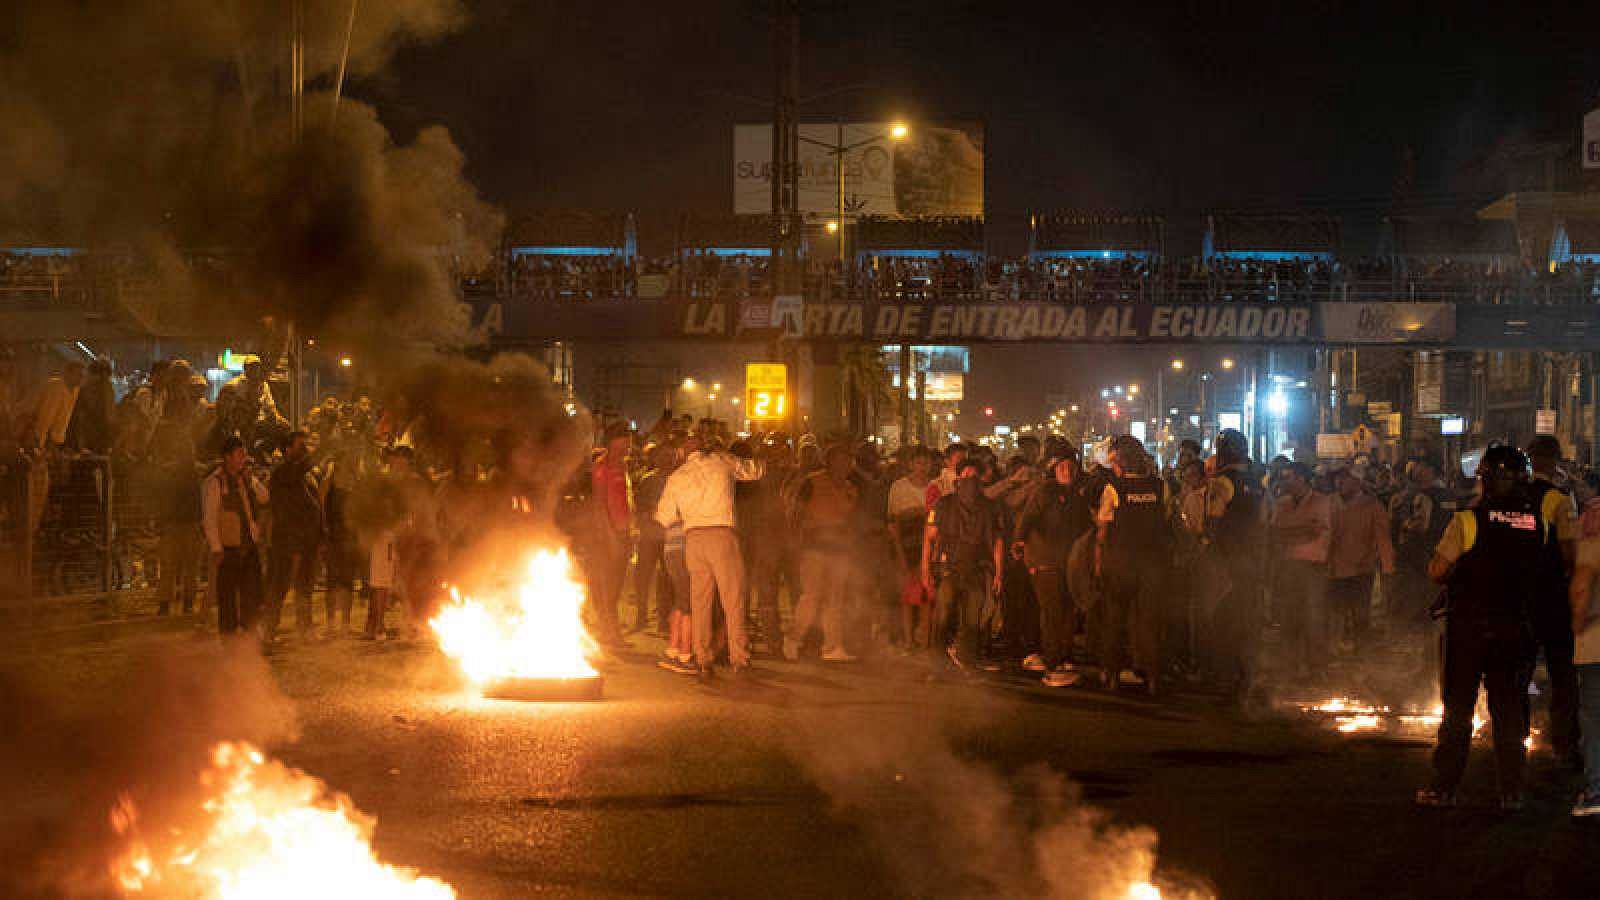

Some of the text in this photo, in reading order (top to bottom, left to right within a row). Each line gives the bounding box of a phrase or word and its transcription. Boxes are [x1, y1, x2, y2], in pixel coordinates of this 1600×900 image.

[684, 304, 725, 336] LA
[874, 304, 927, 337] DE
[929, 304, 1087, 337] ENTRADA
[1096, 304, 1137, 337] AL
[1150, 304, 1311, 337] ECUADOR
[755, 392, 786, 416] 21
